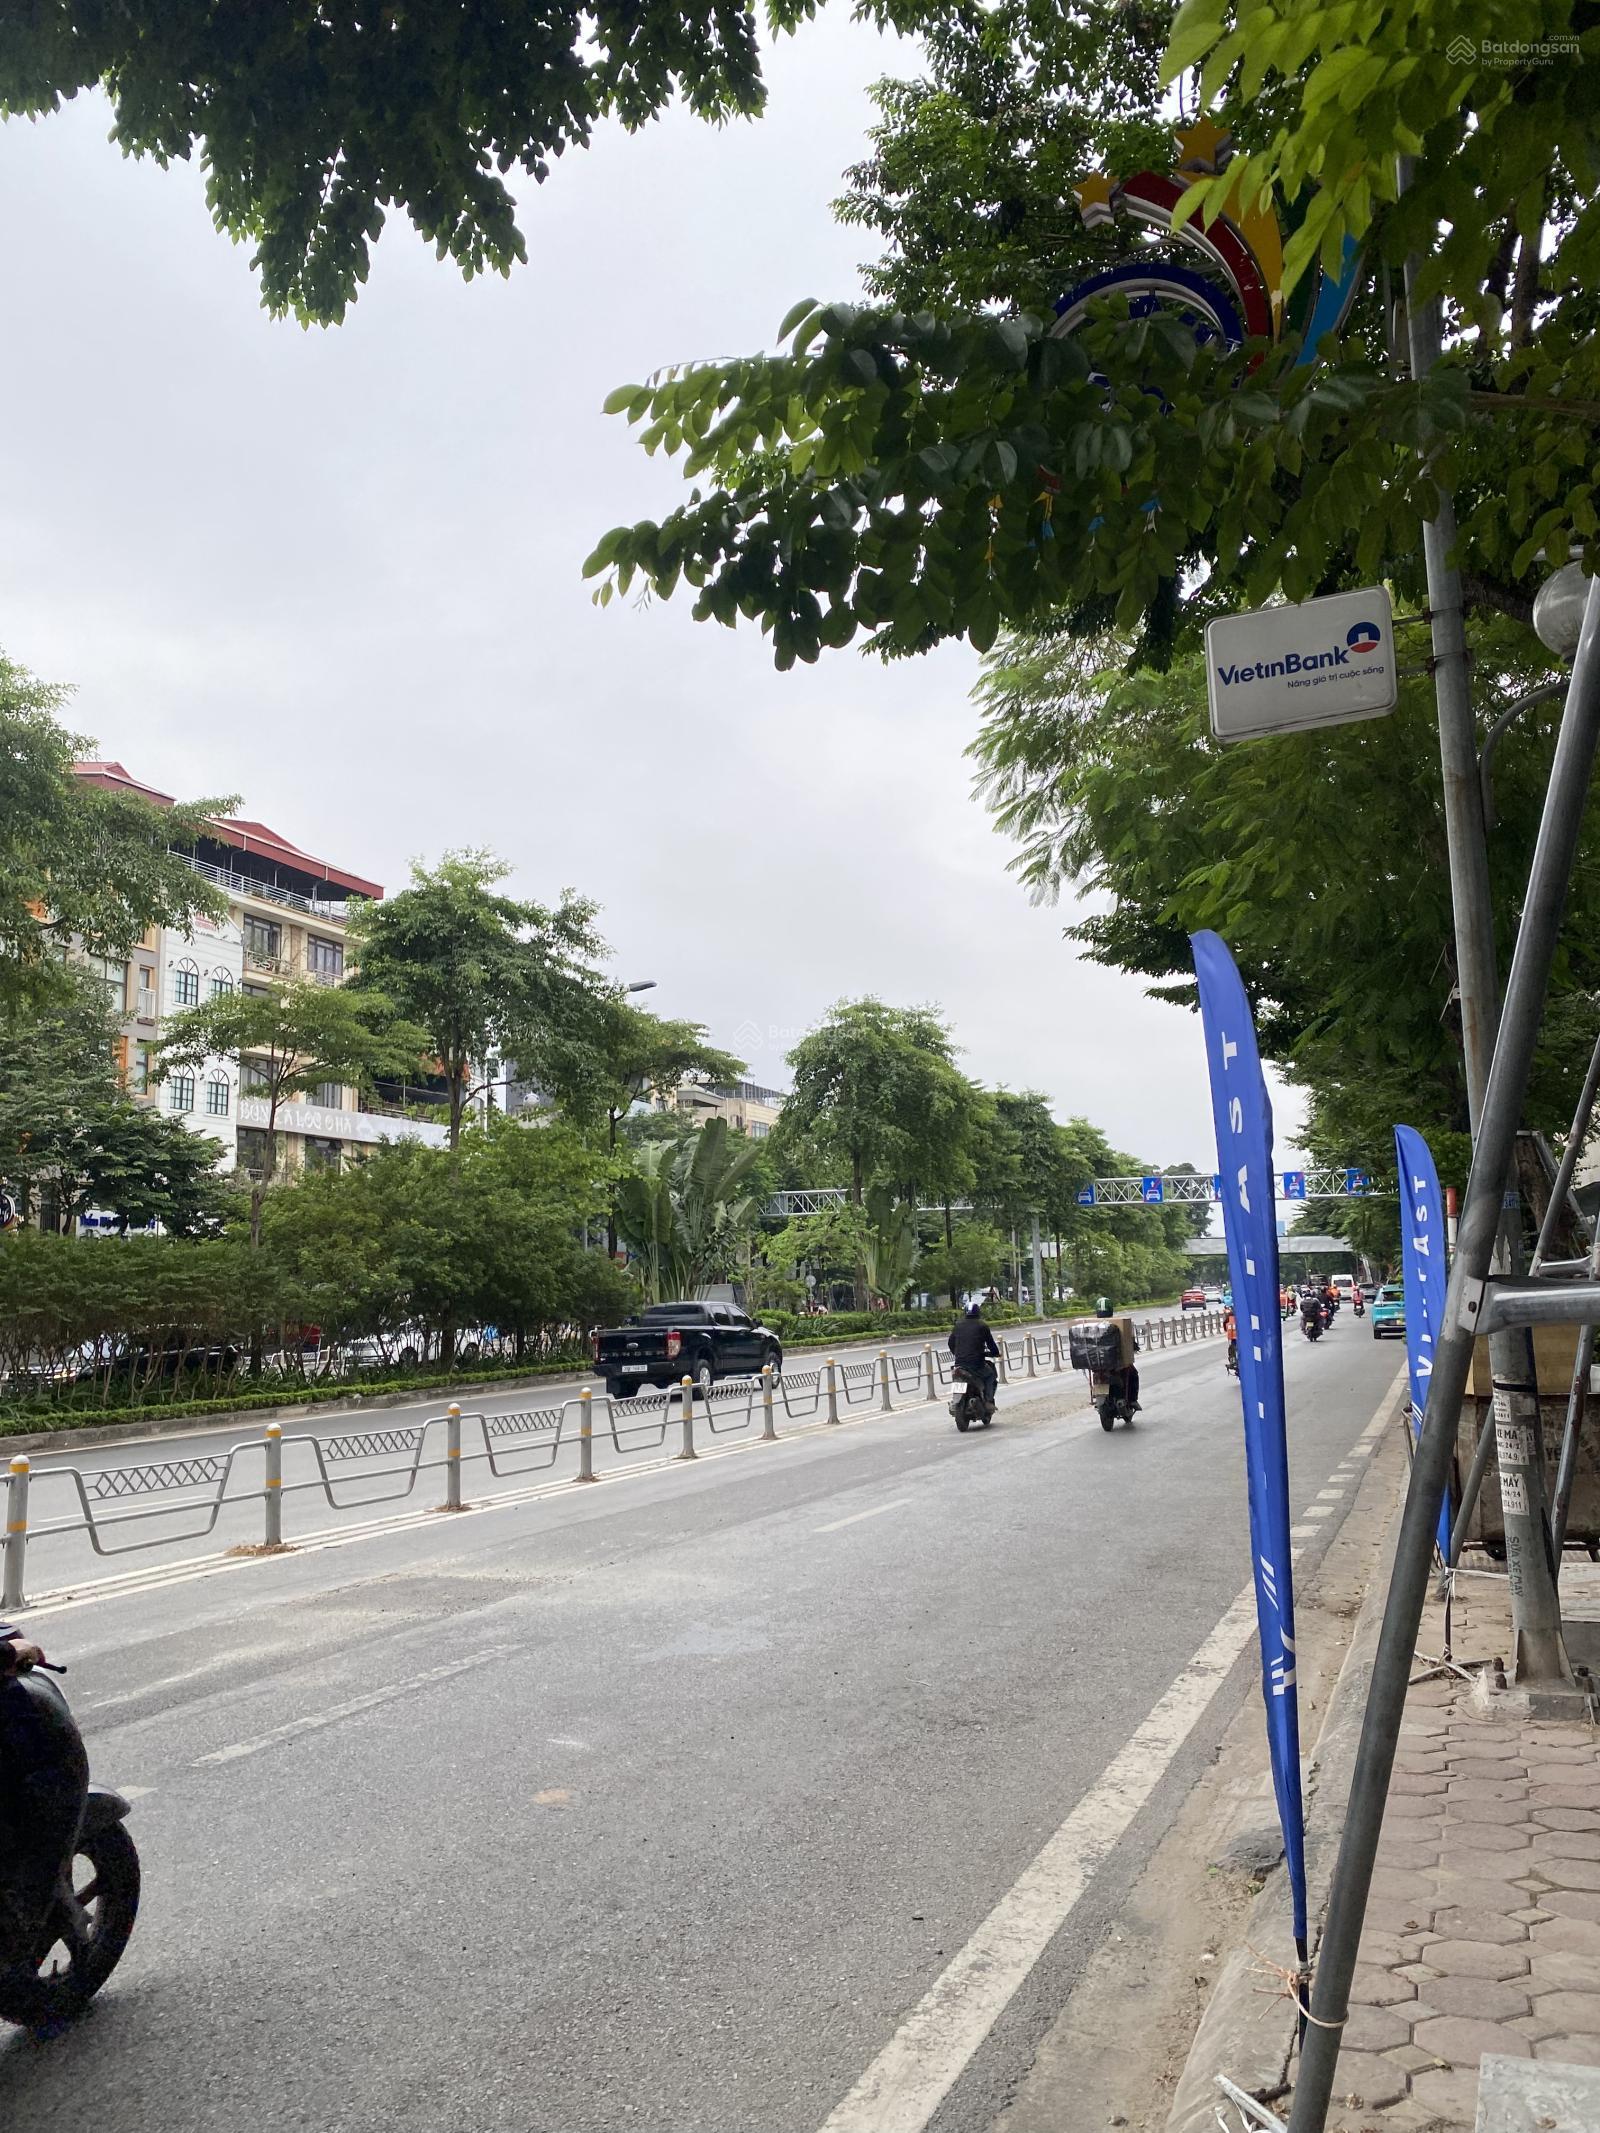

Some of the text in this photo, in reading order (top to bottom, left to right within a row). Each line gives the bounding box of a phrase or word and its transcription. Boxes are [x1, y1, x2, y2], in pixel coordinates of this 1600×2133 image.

[1217, 645, 1350, 686] VietinBank
[1328, 671, 1338, 682] trị
[1339, 669, 1361, 681] cuộc
[1362, 665, 1385, 676] sống
